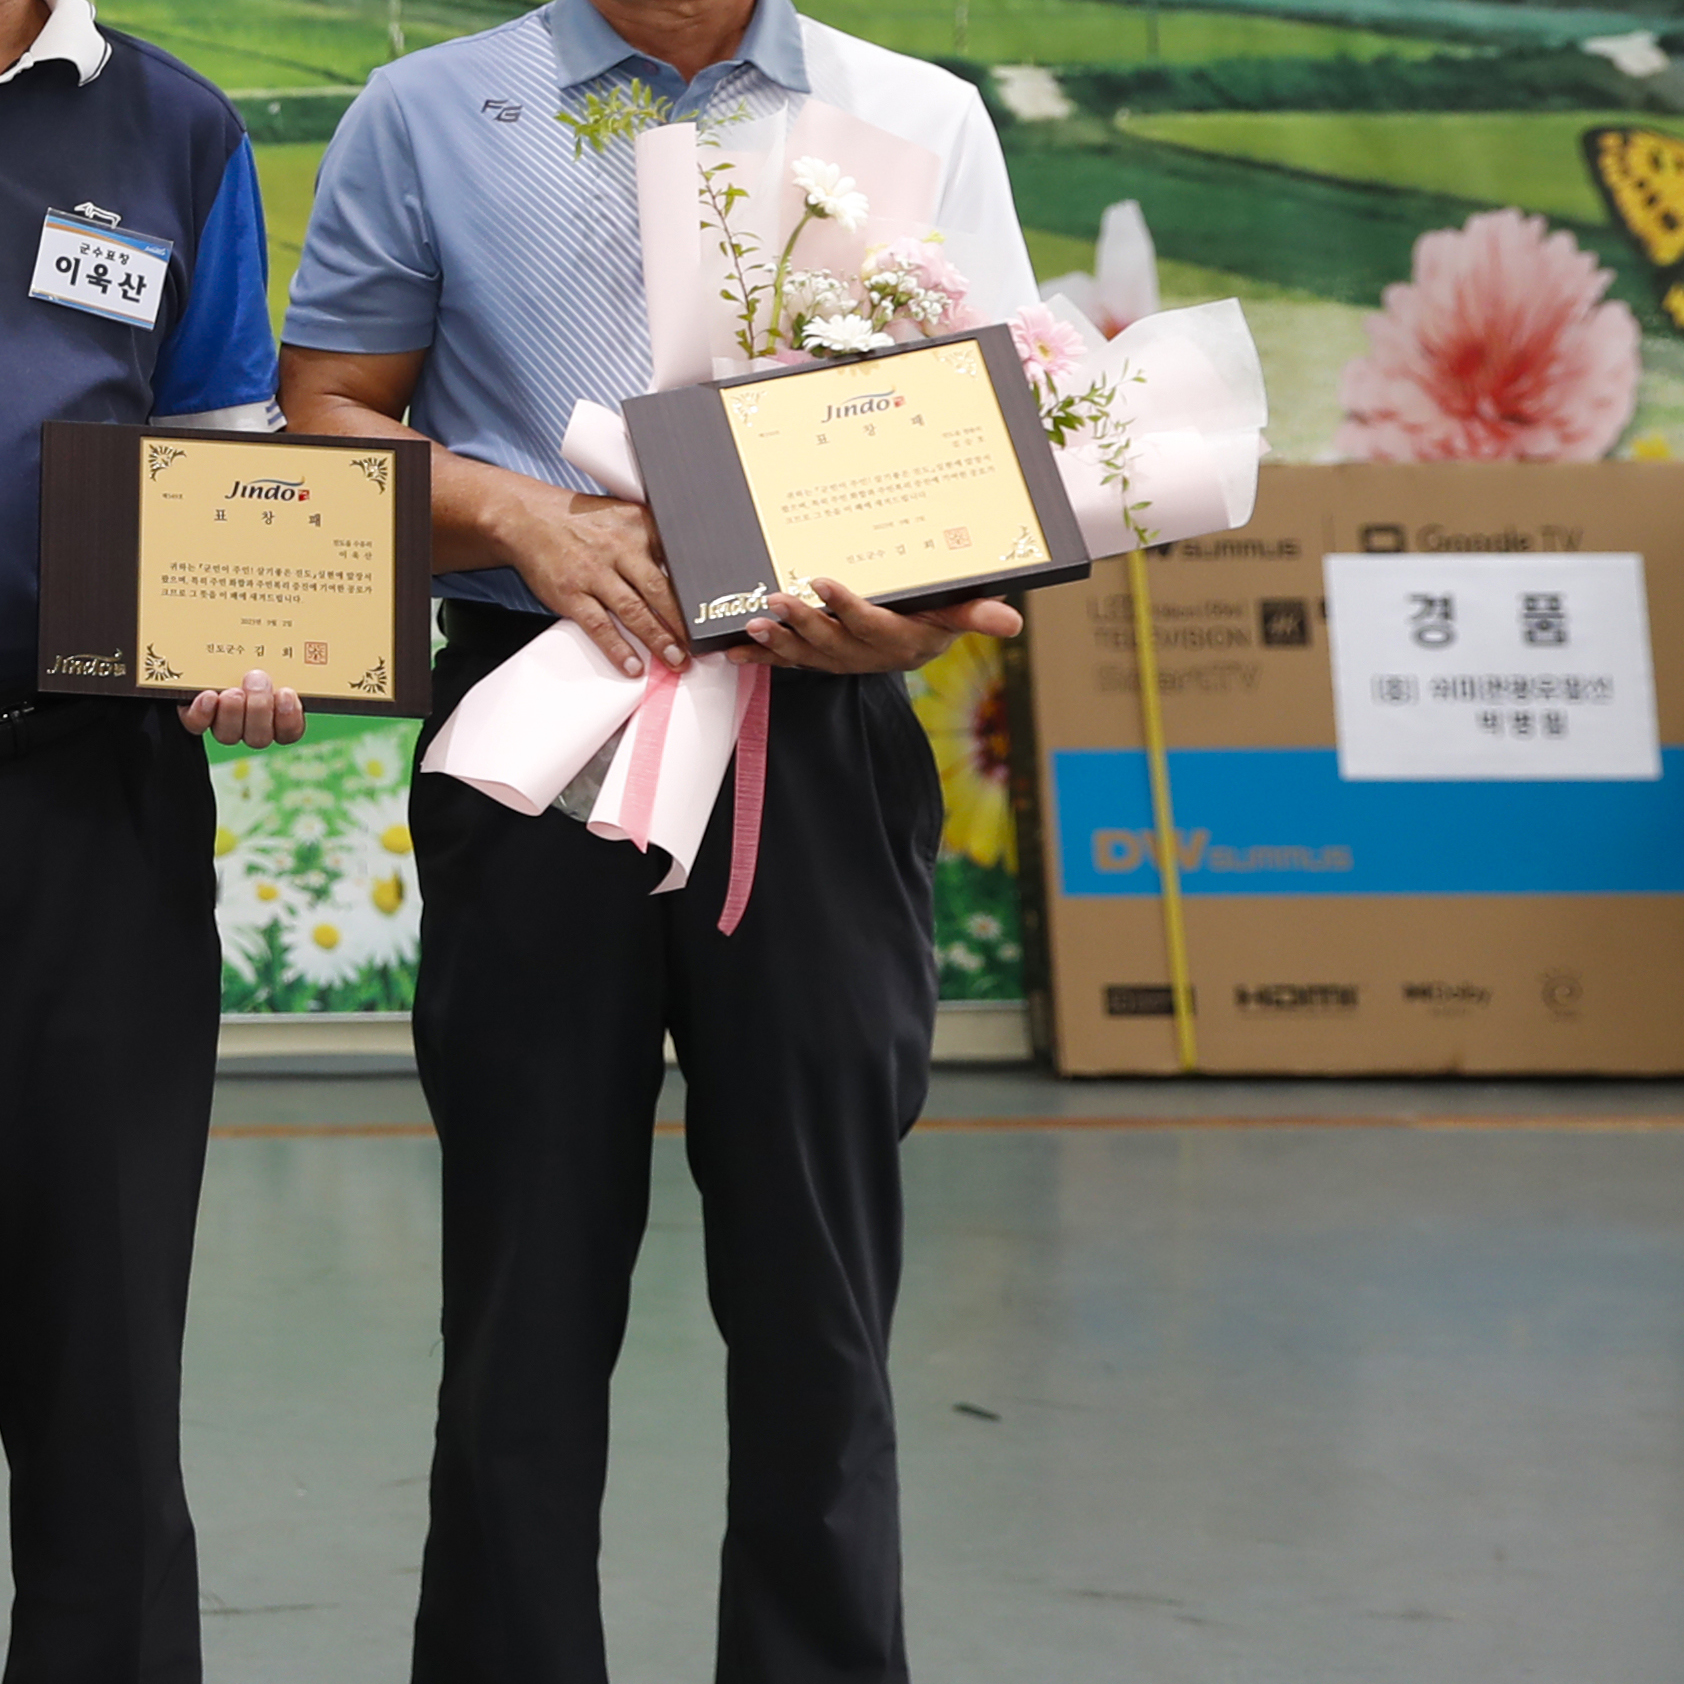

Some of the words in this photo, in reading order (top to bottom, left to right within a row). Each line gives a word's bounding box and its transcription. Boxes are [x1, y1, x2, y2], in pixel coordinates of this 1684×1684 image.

[80, 242, 130, 265] 군수표창
[821, 397, 890, 423] Jindo
[225, 481, 295, 501] Jindo
[214, 509, 227, 521] 표
[262, 511, 275, 525] 창
[309, 513, 321, 527] 패
